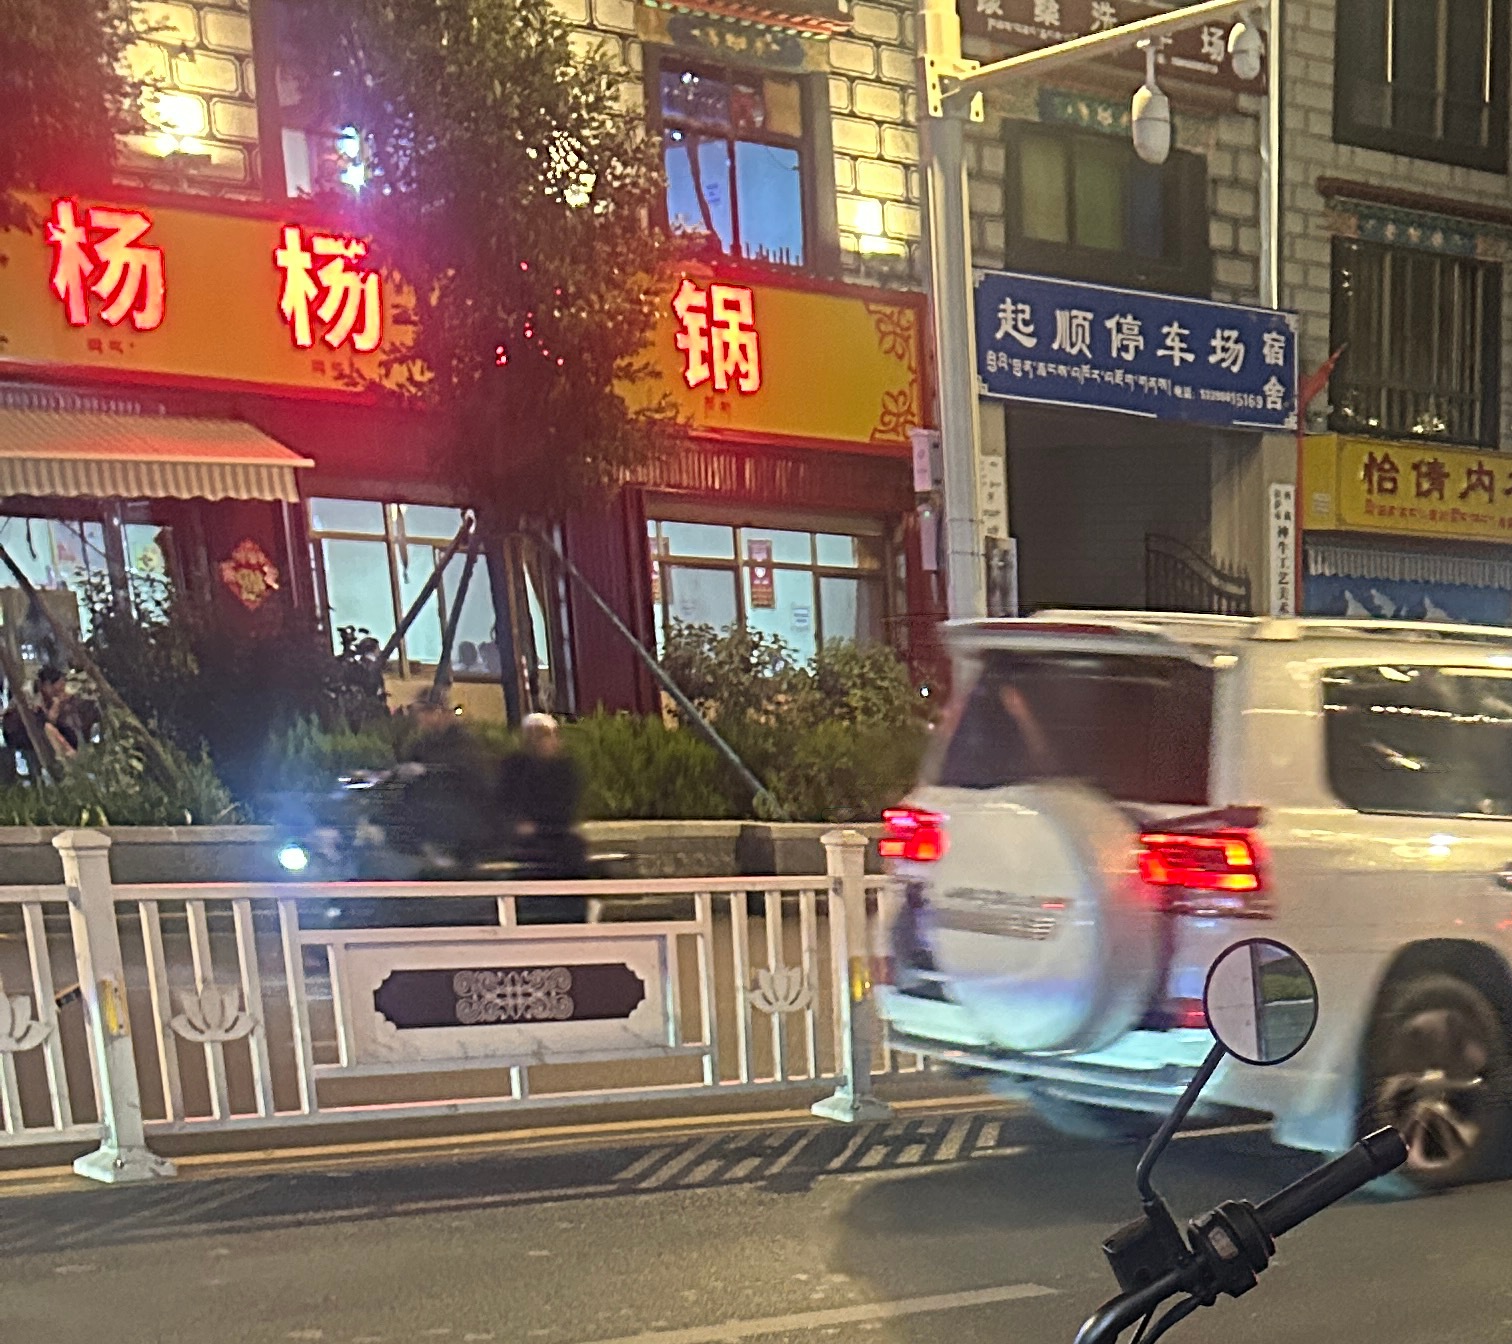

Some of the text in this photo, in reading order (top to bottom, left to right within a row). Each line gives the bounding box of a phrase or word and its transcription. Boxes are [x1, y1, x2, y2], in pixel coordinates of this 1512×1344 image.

[994, 297, 1246, 373] 起顺停车场
[1262, 330, 1288, 411] 宿舍
